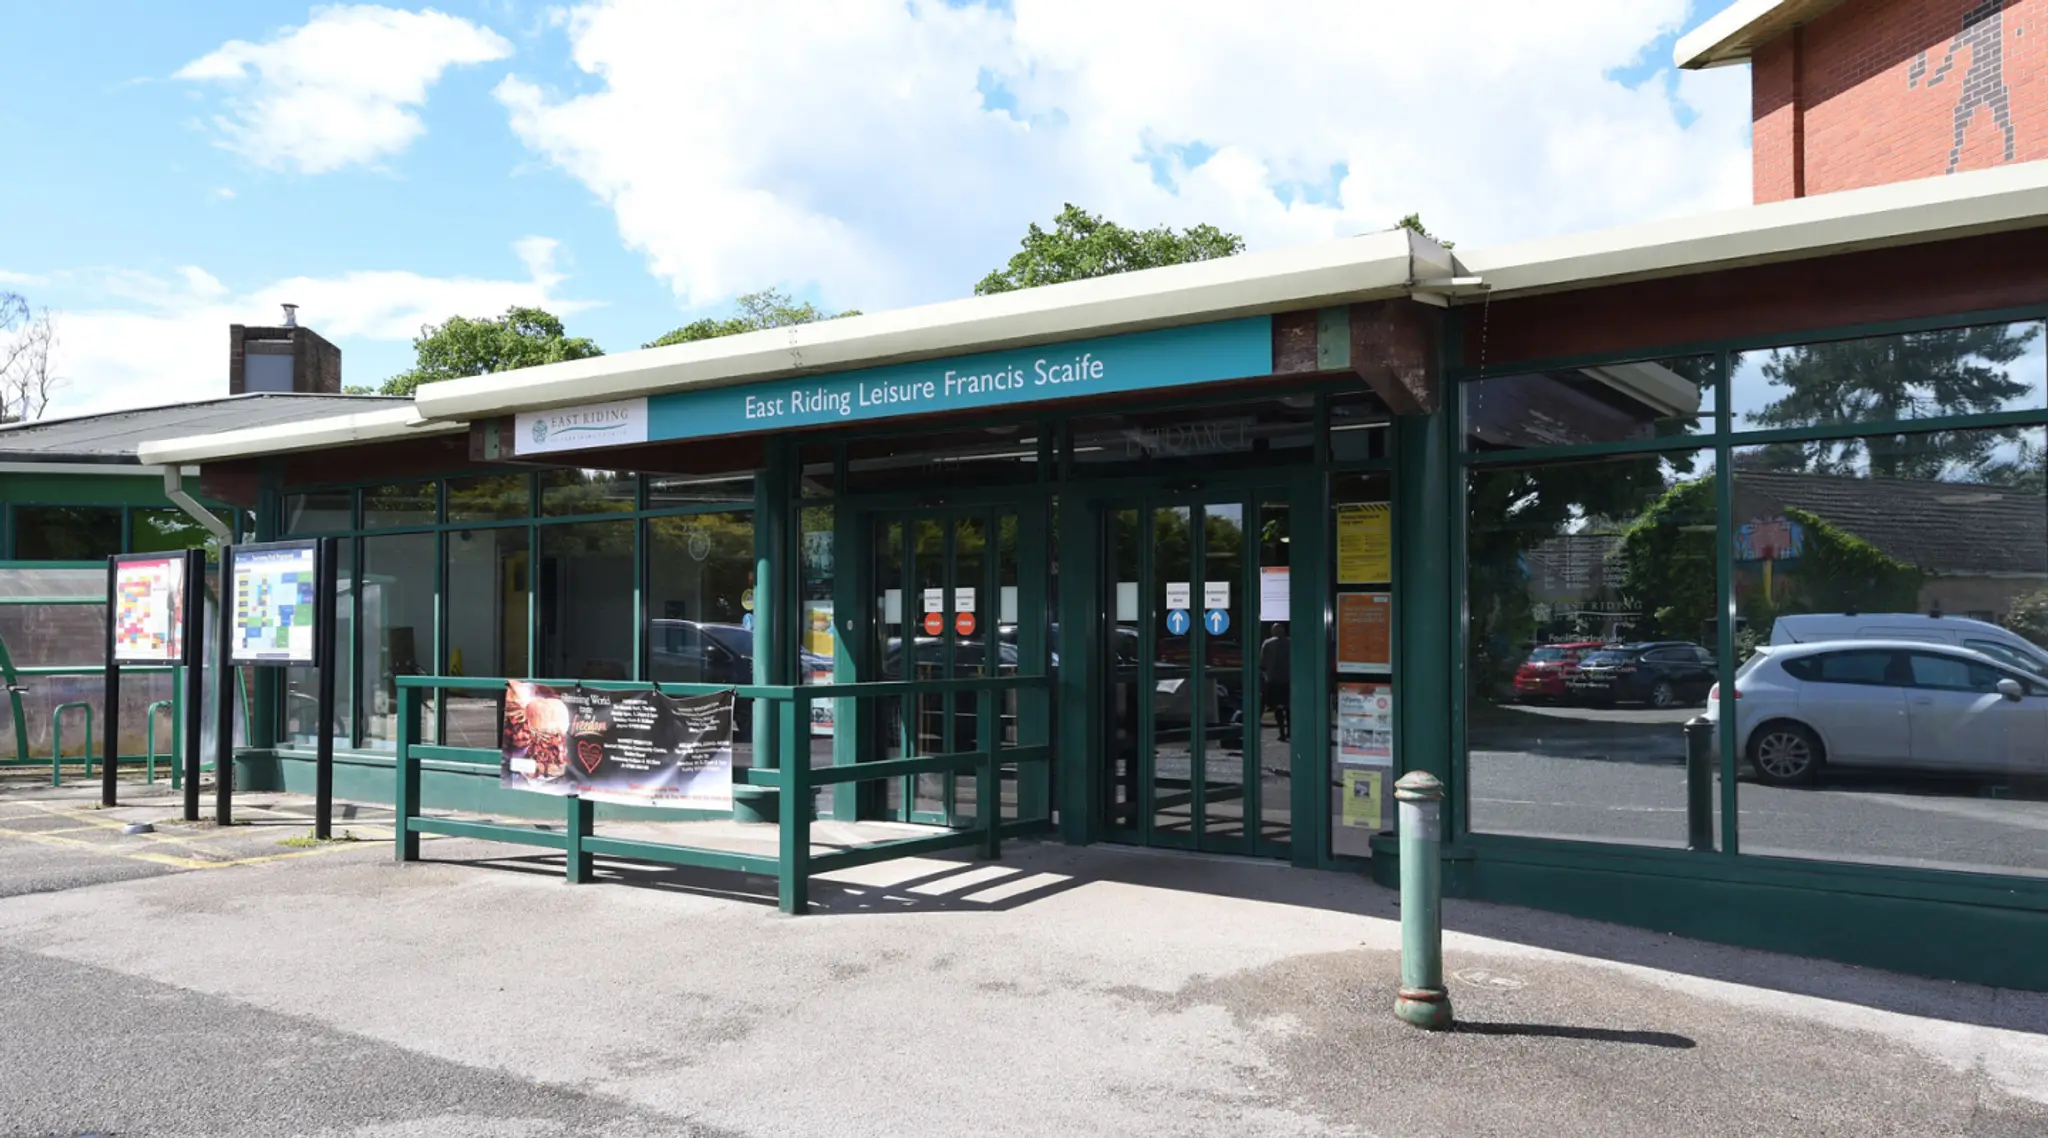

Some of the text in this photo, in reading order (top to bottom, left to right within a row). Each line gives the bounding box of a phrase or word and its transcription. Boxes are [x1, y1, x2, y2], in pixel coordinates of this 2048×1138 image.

[745, 353, 1105, 419] East Riding Leisure Francis Scaife
[551, 407, 629, 429] EAST RIDING
[571, 713, 607, 736] freedom
